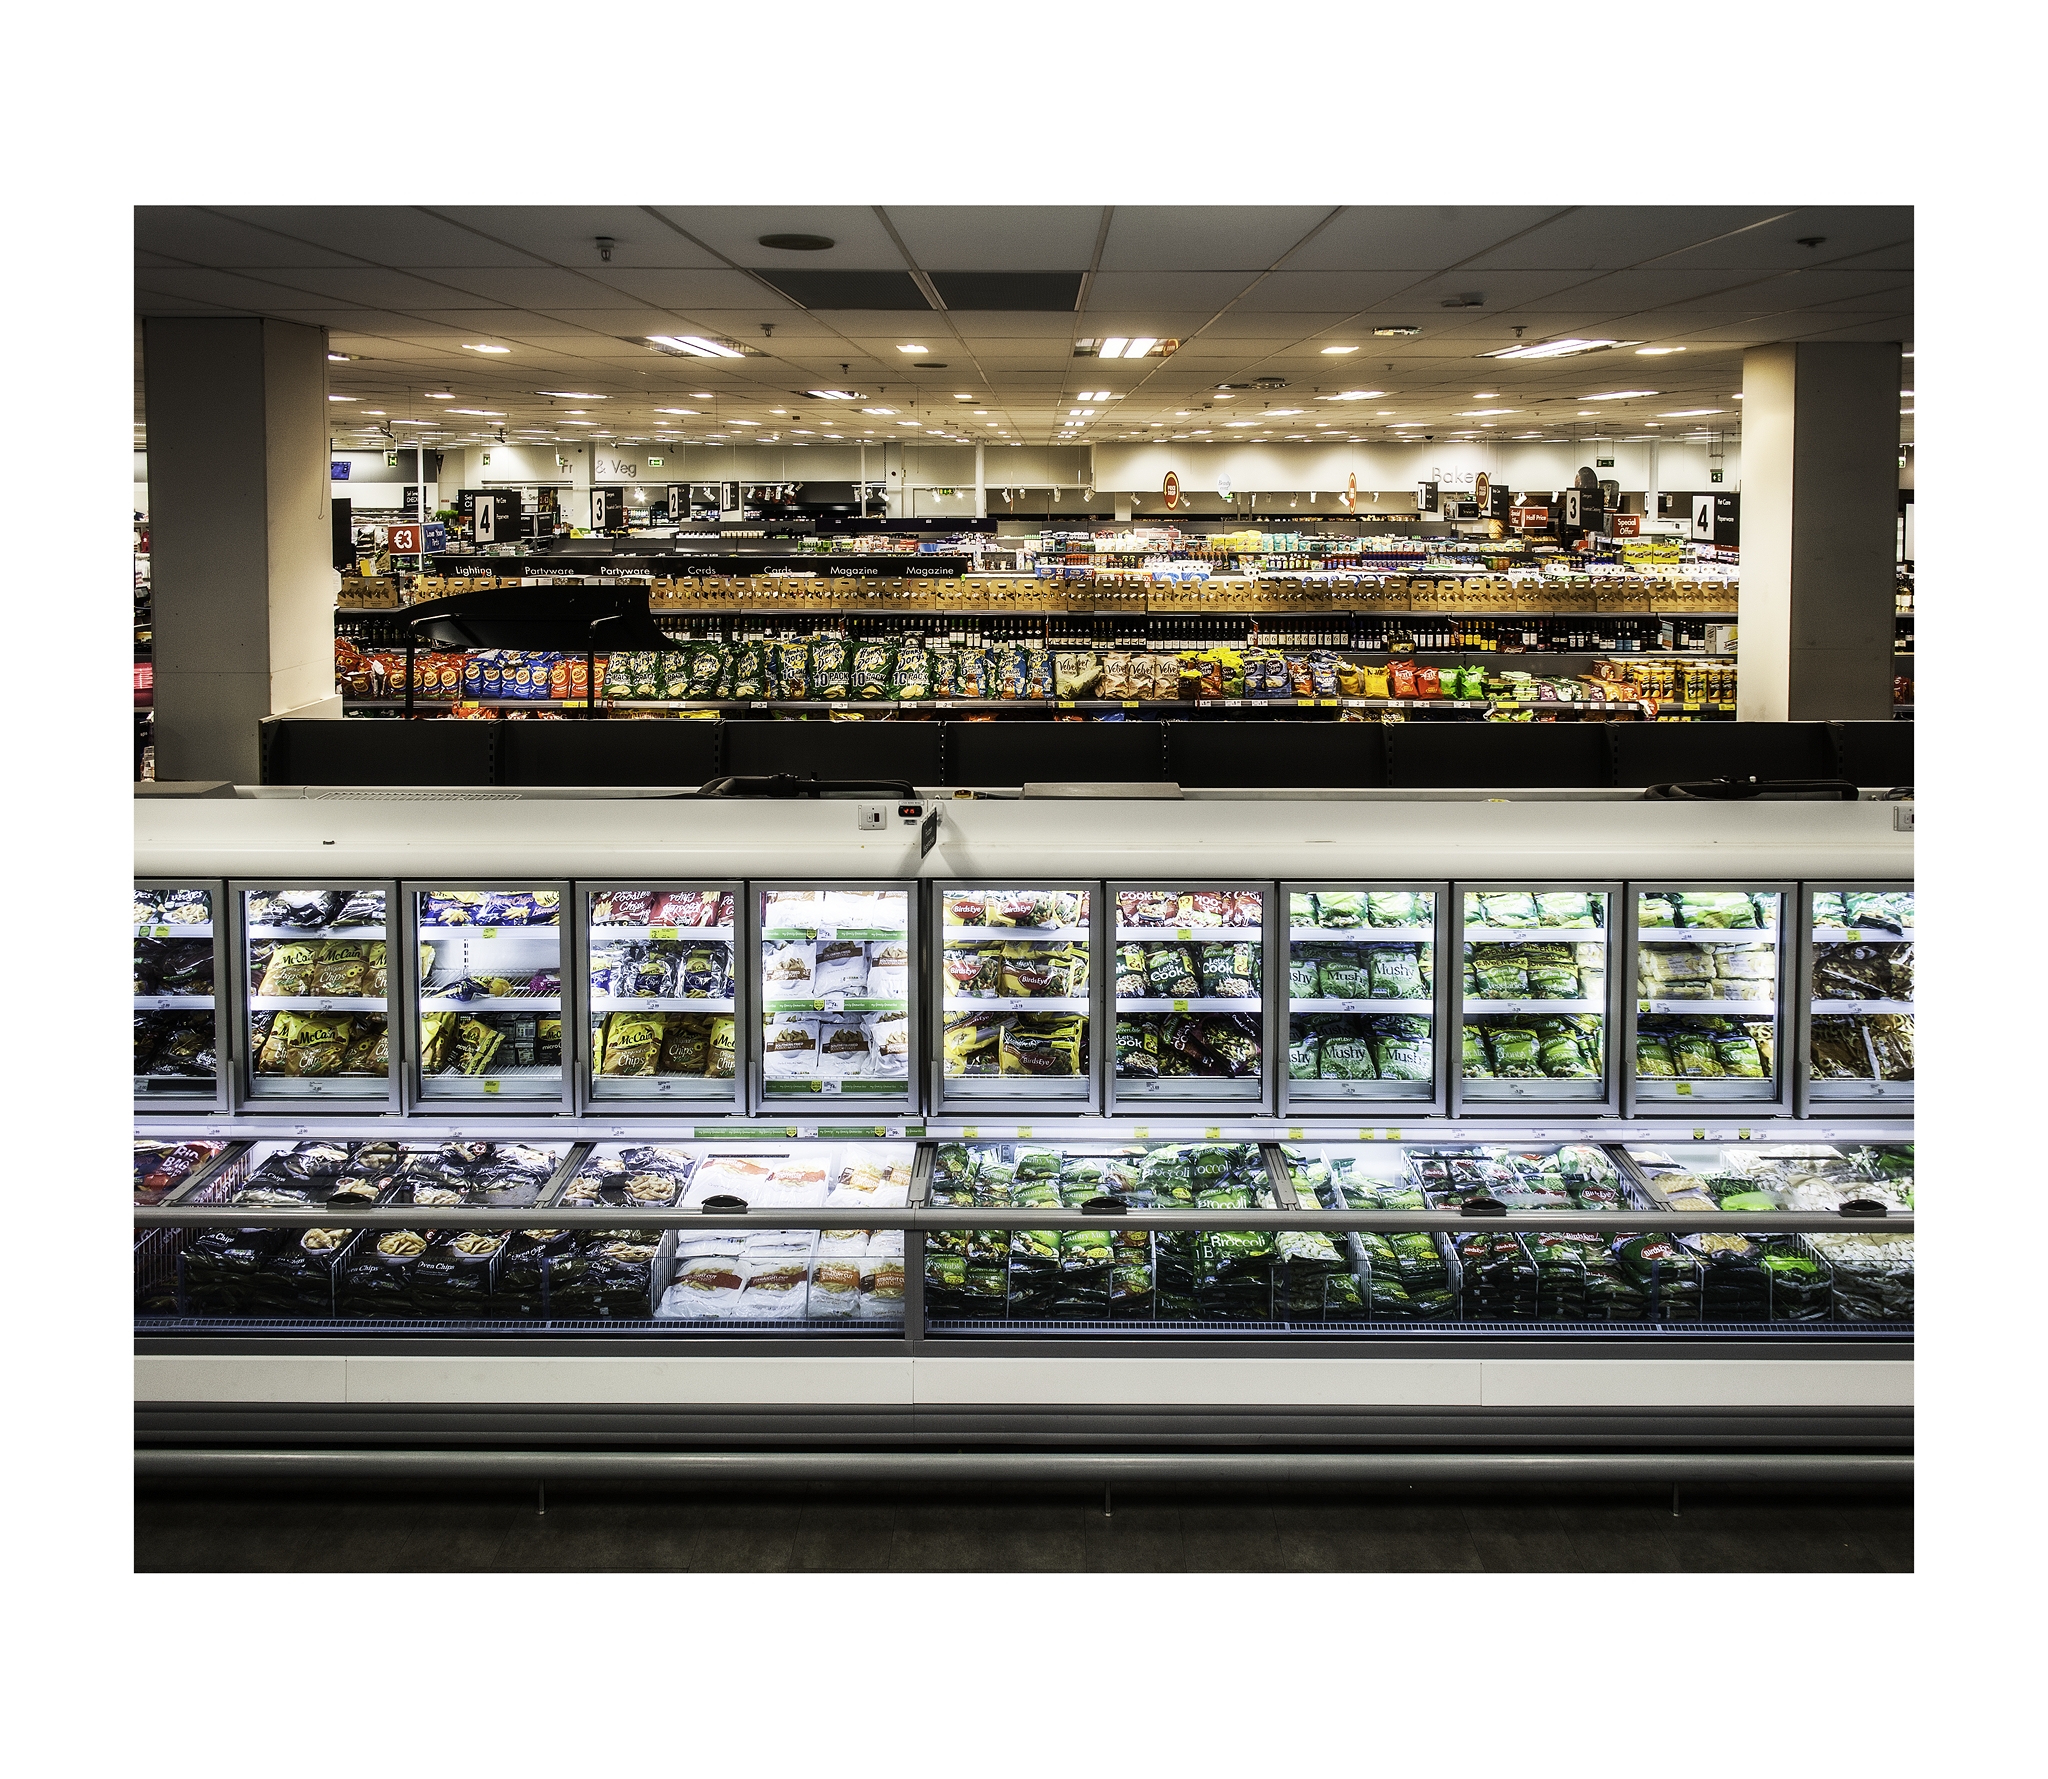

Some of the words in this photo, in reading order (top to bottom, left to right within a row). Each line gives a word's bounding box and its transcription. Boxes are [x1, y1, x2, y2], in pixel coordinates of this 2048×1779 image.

[611, 460, 637, 478] Veg
[671, 493, 676, 512] 2
[1570, 496, 1576, 520] 3
[596, 498, 602, 521] 3
[480, 504, 490, 534] 4
[1618, 518, 1636, 528] Special
[1698, 504, 1708, 532] 4
[1620, 528, 1634, 536] Offer
[394, 530, 413, 549] €3
[456, 566, 492, 576] Lighting
[524, 566, 574, 576] Partyware
[600, 566, 650, 576] Partyware
[688, 566, 716, 575] Cards
[764, 566, 793, 575] Cards
[830, 566, 879, 576] Magazine
[906, 566, 954, 576] Magazine
[814, 672, 828, 687] 10
[830, 672, 850, 680] PACK
[851, 672, 866, 686] 10
[893, 672, 907, 685] 10
[620, 902, 645, 912] Chips
[324, 949, 361, 961] McCain
[1150, 967, 1185, 982] Cook
[1202, 963, 1234, 974] Cook
[1374, 963, 1415, 980] Mushy
[320, 972, 347, 983] Chips
[619, 1031, 654, 1045] McCain
[1116, 1039, 1142, 1048] ook
[669, 1044, 694, 1056] Chips
[1324, 1046, 1366, 1062] Mushy
[618, 1055, 645, 1067] Chips
[716, 1058, 735, 1070] Chip
[1022, 1058, 1050, 1066] BirdsEye
[162, 1156, 190, 1170] BAG
[1194, 1161, 1232, 1175] roccoli
[216, 1232, 235, 1244] Chips
[1090, 1231, 1106, 1239] Mix
[1211, 1235, 1266, 1248] Broccoli
[359, 1265, 380, 1273] Chips
[417, 1261, 434, 1270] Oven
[436, 1262, 456, 1271] Chips
[592, 1262, 612, 1273] Chips
